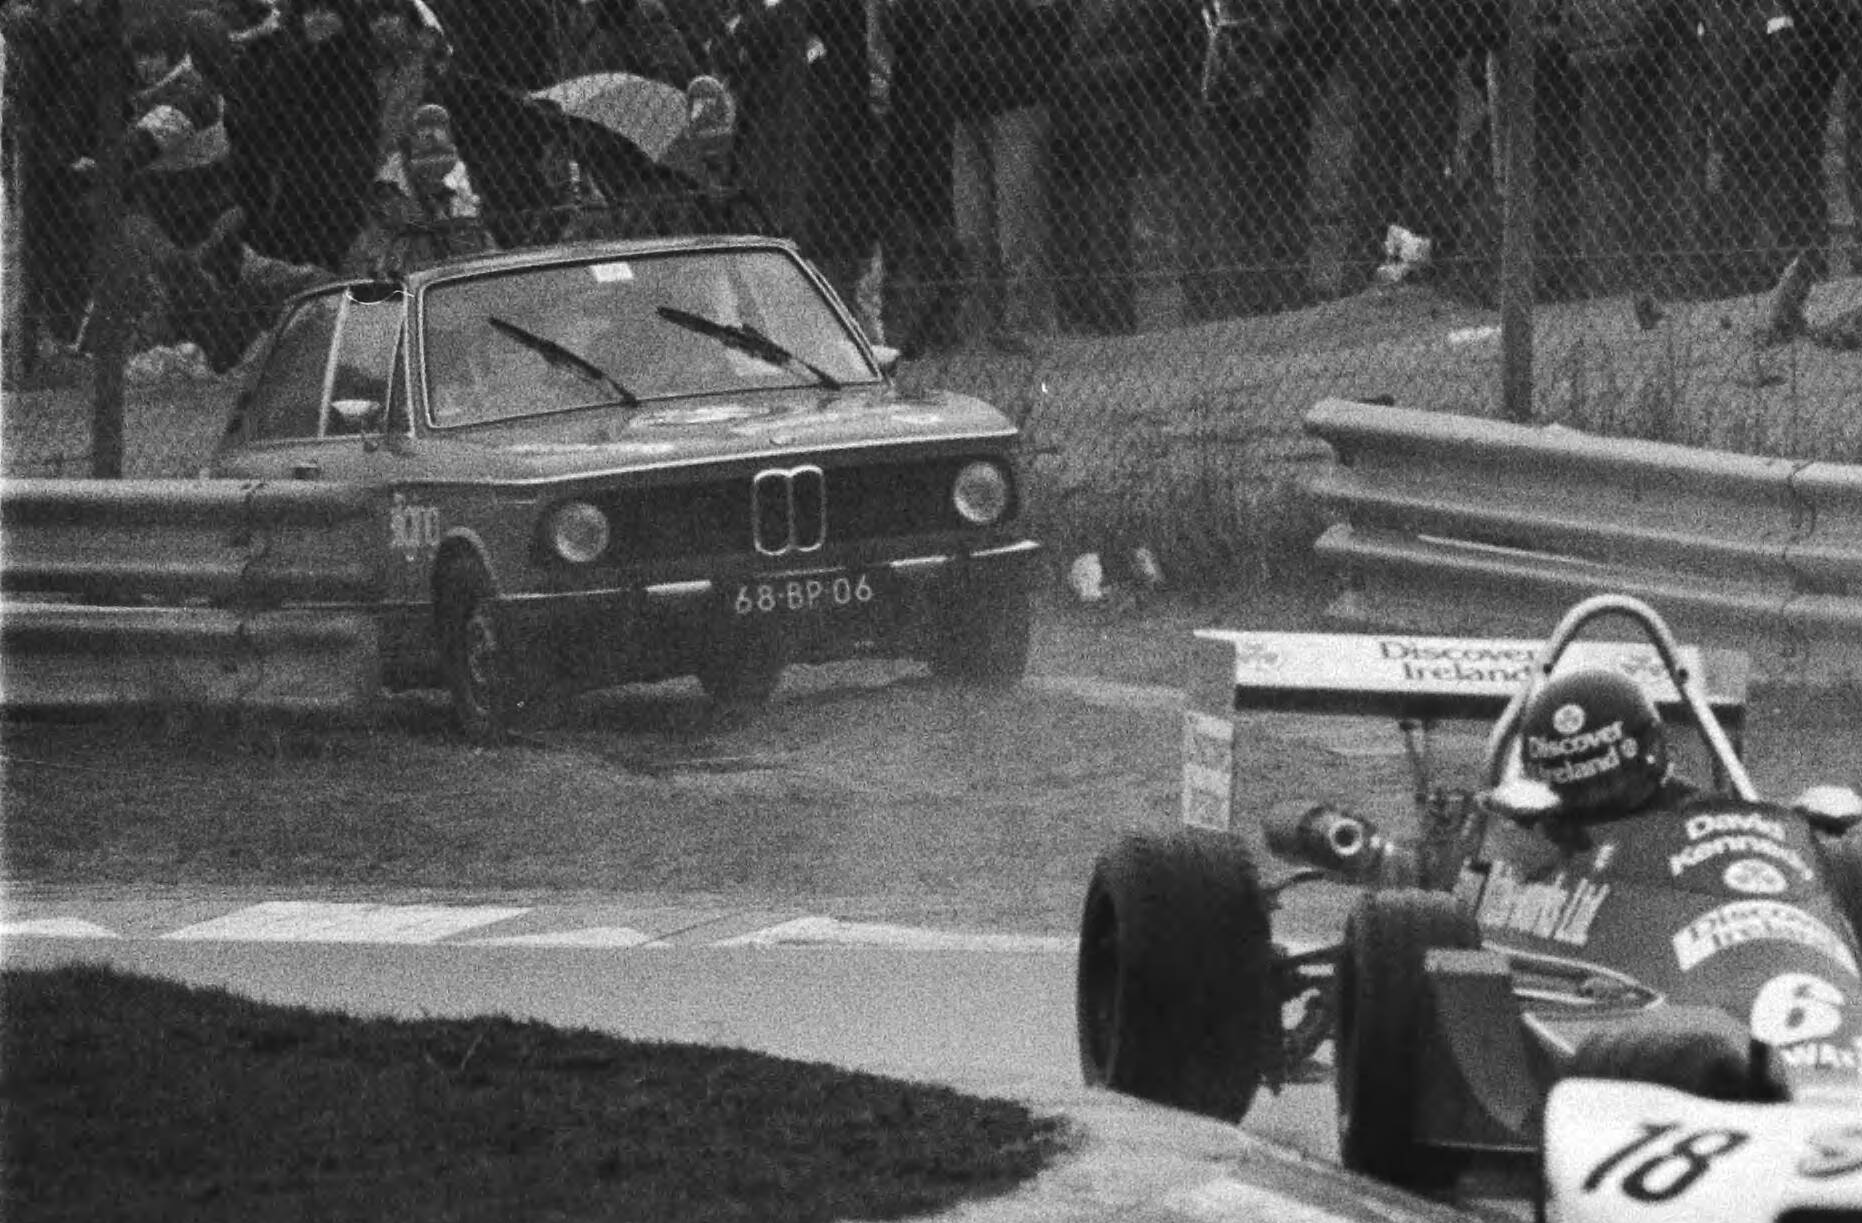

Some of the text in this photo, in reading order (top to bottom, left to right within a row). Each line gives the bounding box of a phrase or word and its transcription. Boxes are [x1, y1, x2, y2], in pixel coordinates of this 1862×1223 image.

[1379, 641, 1536, 662] Discover
[1403, 661, 1533, 682] Ireland
[1751, 972, 1846, 1046] 6
[1581, 1120, 1751, 1205] 18
